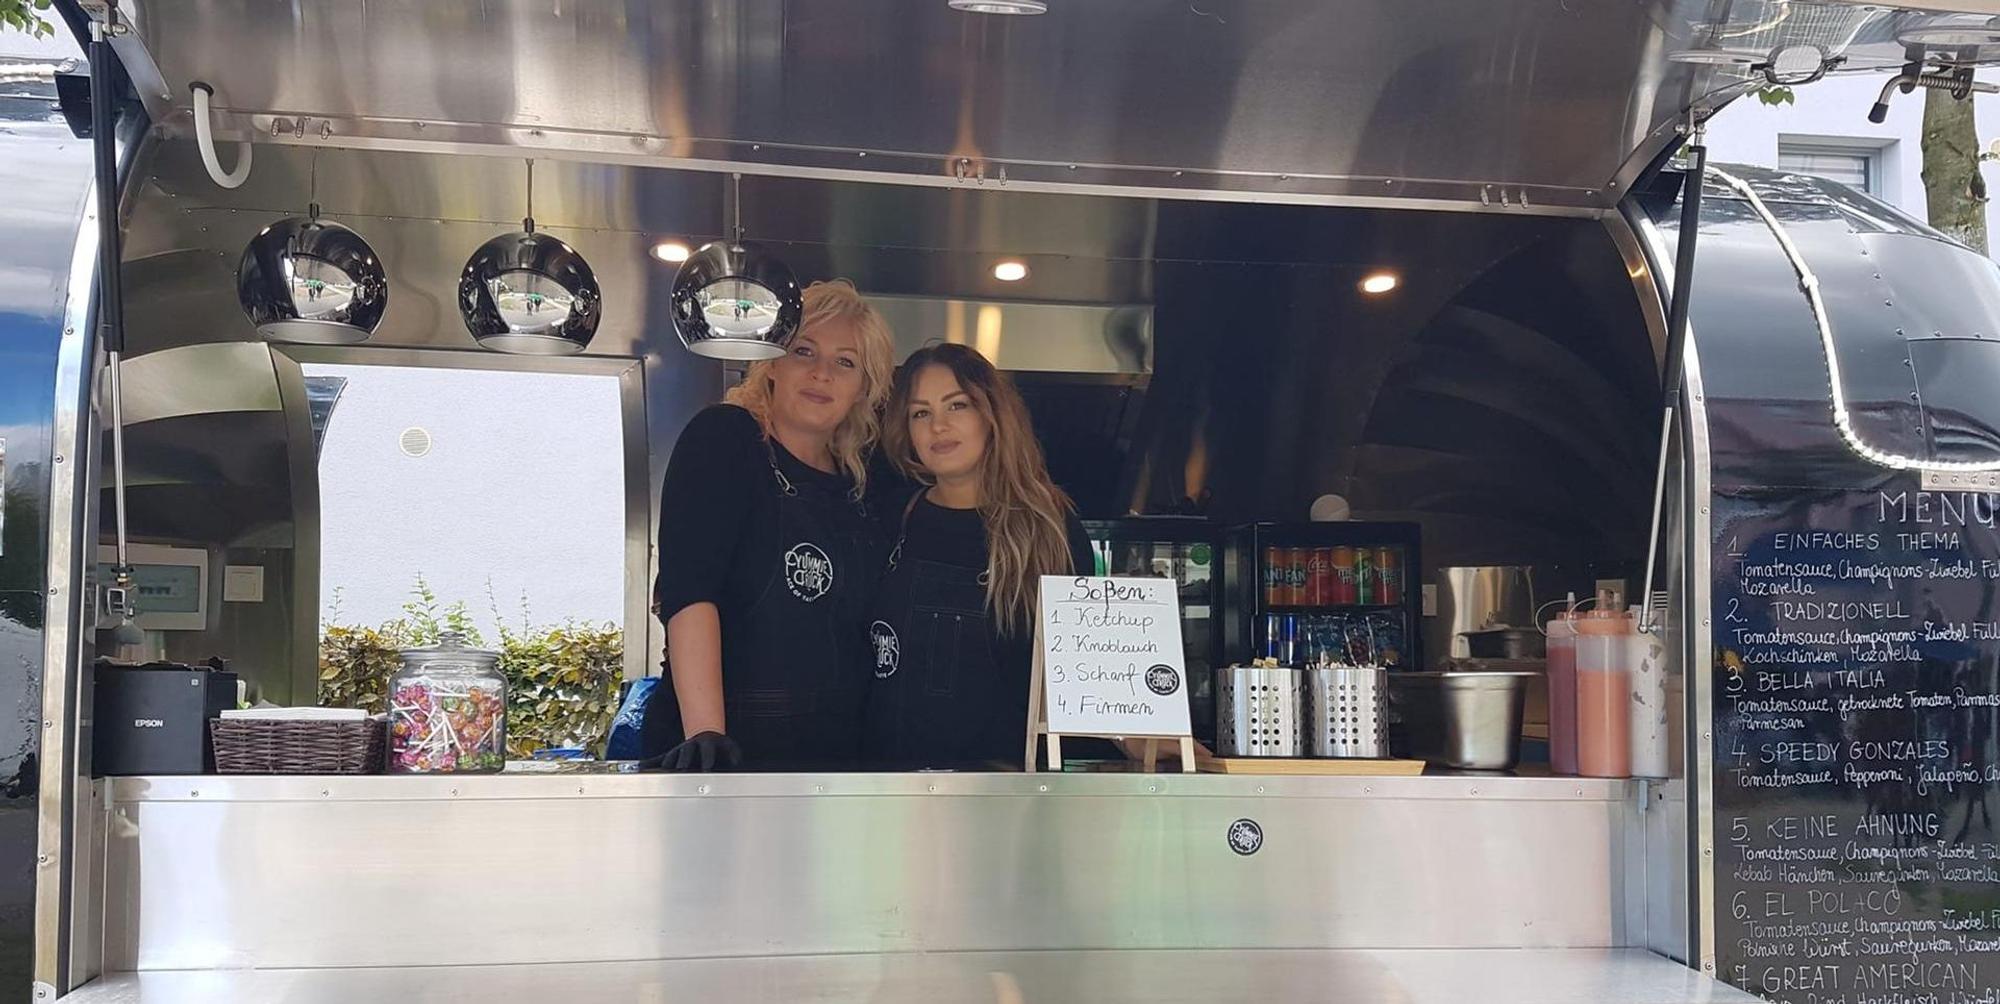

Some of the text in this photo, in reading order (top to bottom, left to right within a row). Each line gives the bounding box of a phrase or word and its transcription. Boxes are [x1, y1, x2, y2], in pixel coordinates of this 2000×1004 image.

[1879, 491, 1996, 528] MENU
[1774, 533, 1880, 551] EINFACHES
[1896, 531, 1960, 551] THEMA
[1075, 607, 1154, 633] Ketchup
[1725, 598, 1910, 623] 2. TRADIZIONELL
[1072, 634, 1158, 654] Knoblauch
[1053, 665, 1070, 683] 3.
[1076, 662, 1140, 696] Scharf
[1726, 665, 1885, 694] 3. BELLA ITALIA
[1080, 695, 1154, 715] Firmen
[135, 719, 163, 728] EPSON
[1740, 713, 1805, 731] Parmesan
[1731, 736, 1950, 767] 4. SPEEDY GONZALES
[1730, 813, 1939, 842] 5. KEINE AHNUNG
[1732, 890, 1751, 919] 6.
[1765, 892, 1795, 917] EL
[1763, 965, 1840, 993] GREAT
[1854, 963, 1977, 989] AMERICAN
